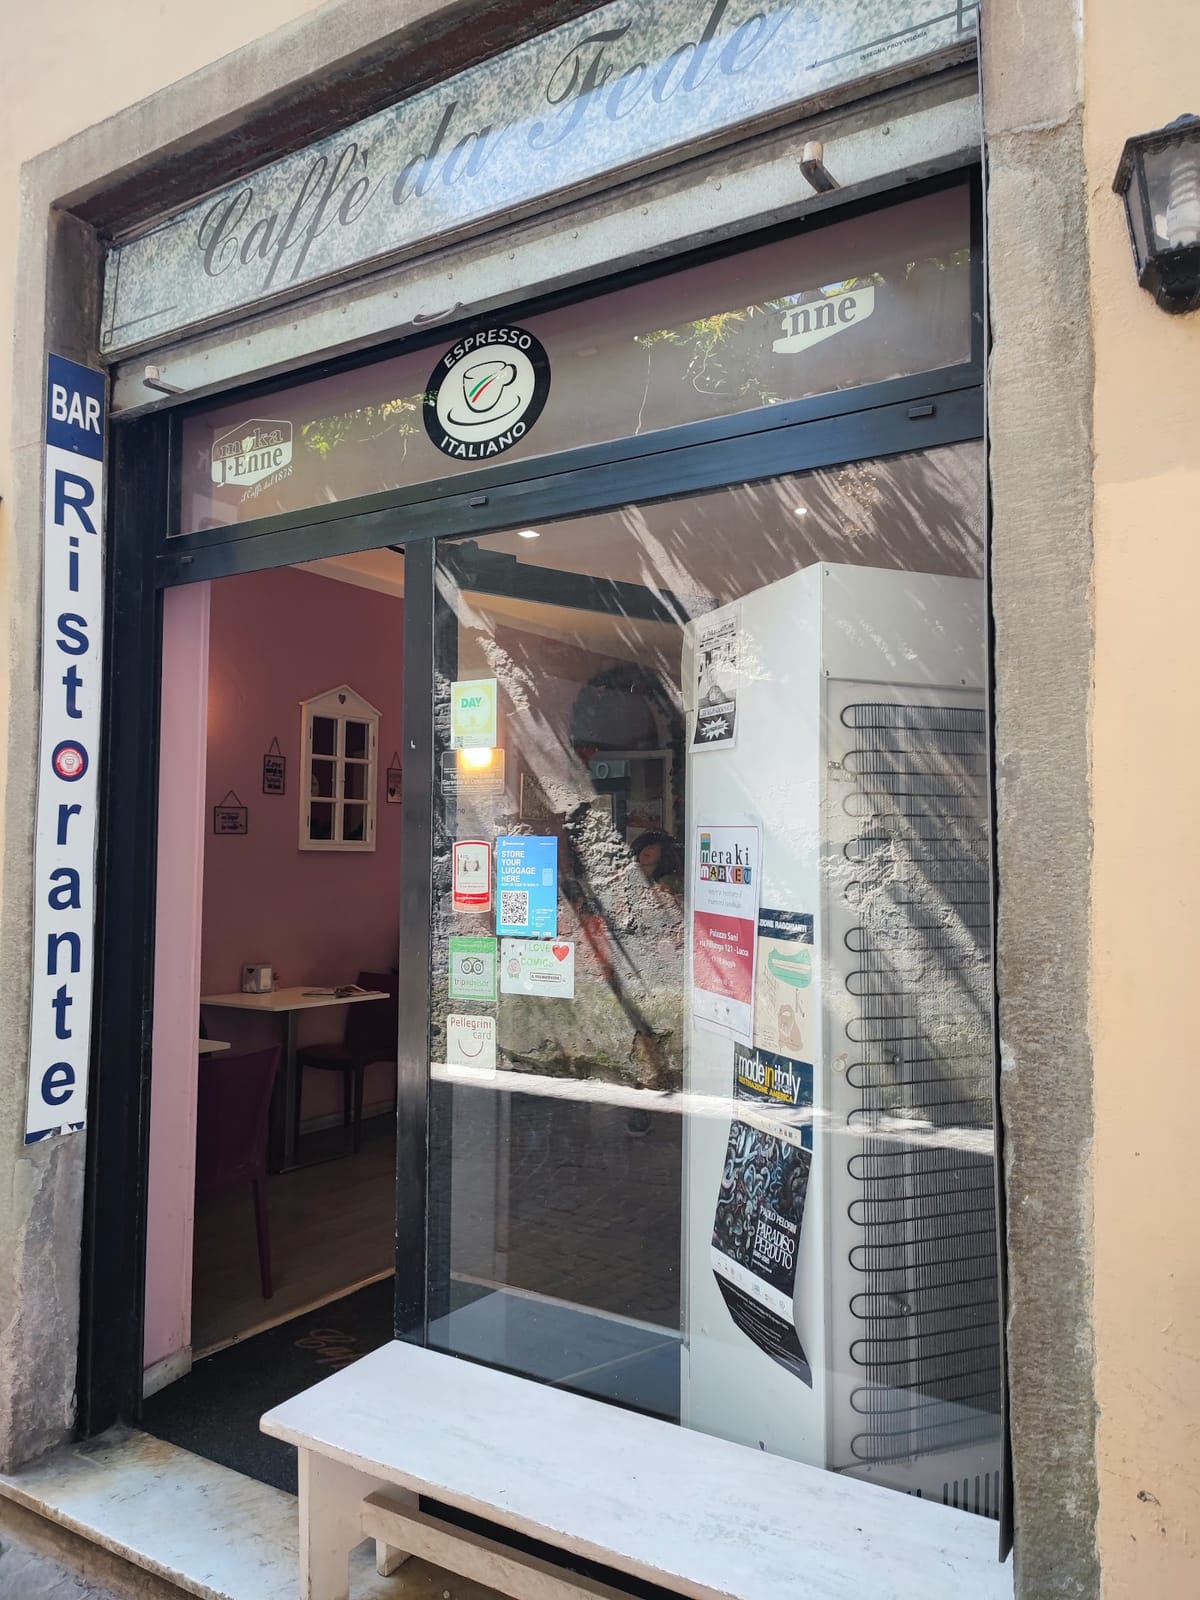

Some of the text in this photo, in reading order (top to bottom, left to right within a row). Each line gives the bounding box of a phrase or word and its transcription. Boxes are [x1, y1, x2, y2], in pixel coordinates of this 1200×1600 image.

[197, 0, 793, 291] Caffè da Fede
[444, 328, 532, 369] ESPRESSO
[52, 384, 101, 434] BAR
[441, 421, 526, 458] ITALIANO
[501, 850, 526, 858] STORE
[700, 843, 749, 866] meraki
[501, 858, 521, 867] YOUR
[501, 866, 537, 875] LUGGAGE
[501, 875, 521, 883] HERE
[528, 943, 551, 953] LOVE
[724, 944, 733, 953] 121
[736, 945, 749, 956] Lucca
[521, 957, 554, 968] COMICS
[450, 1017, 492, 1031] Pellegrini
[472, 1030, 492, 1041] card
[769, 1089, 794, 1104] AMERICA
[760, 1205, 776, 1222] PAOLO
[756, 1219, 795, 1255] PARADISO
[753, 1234, 793, 1270] PERDUTO
